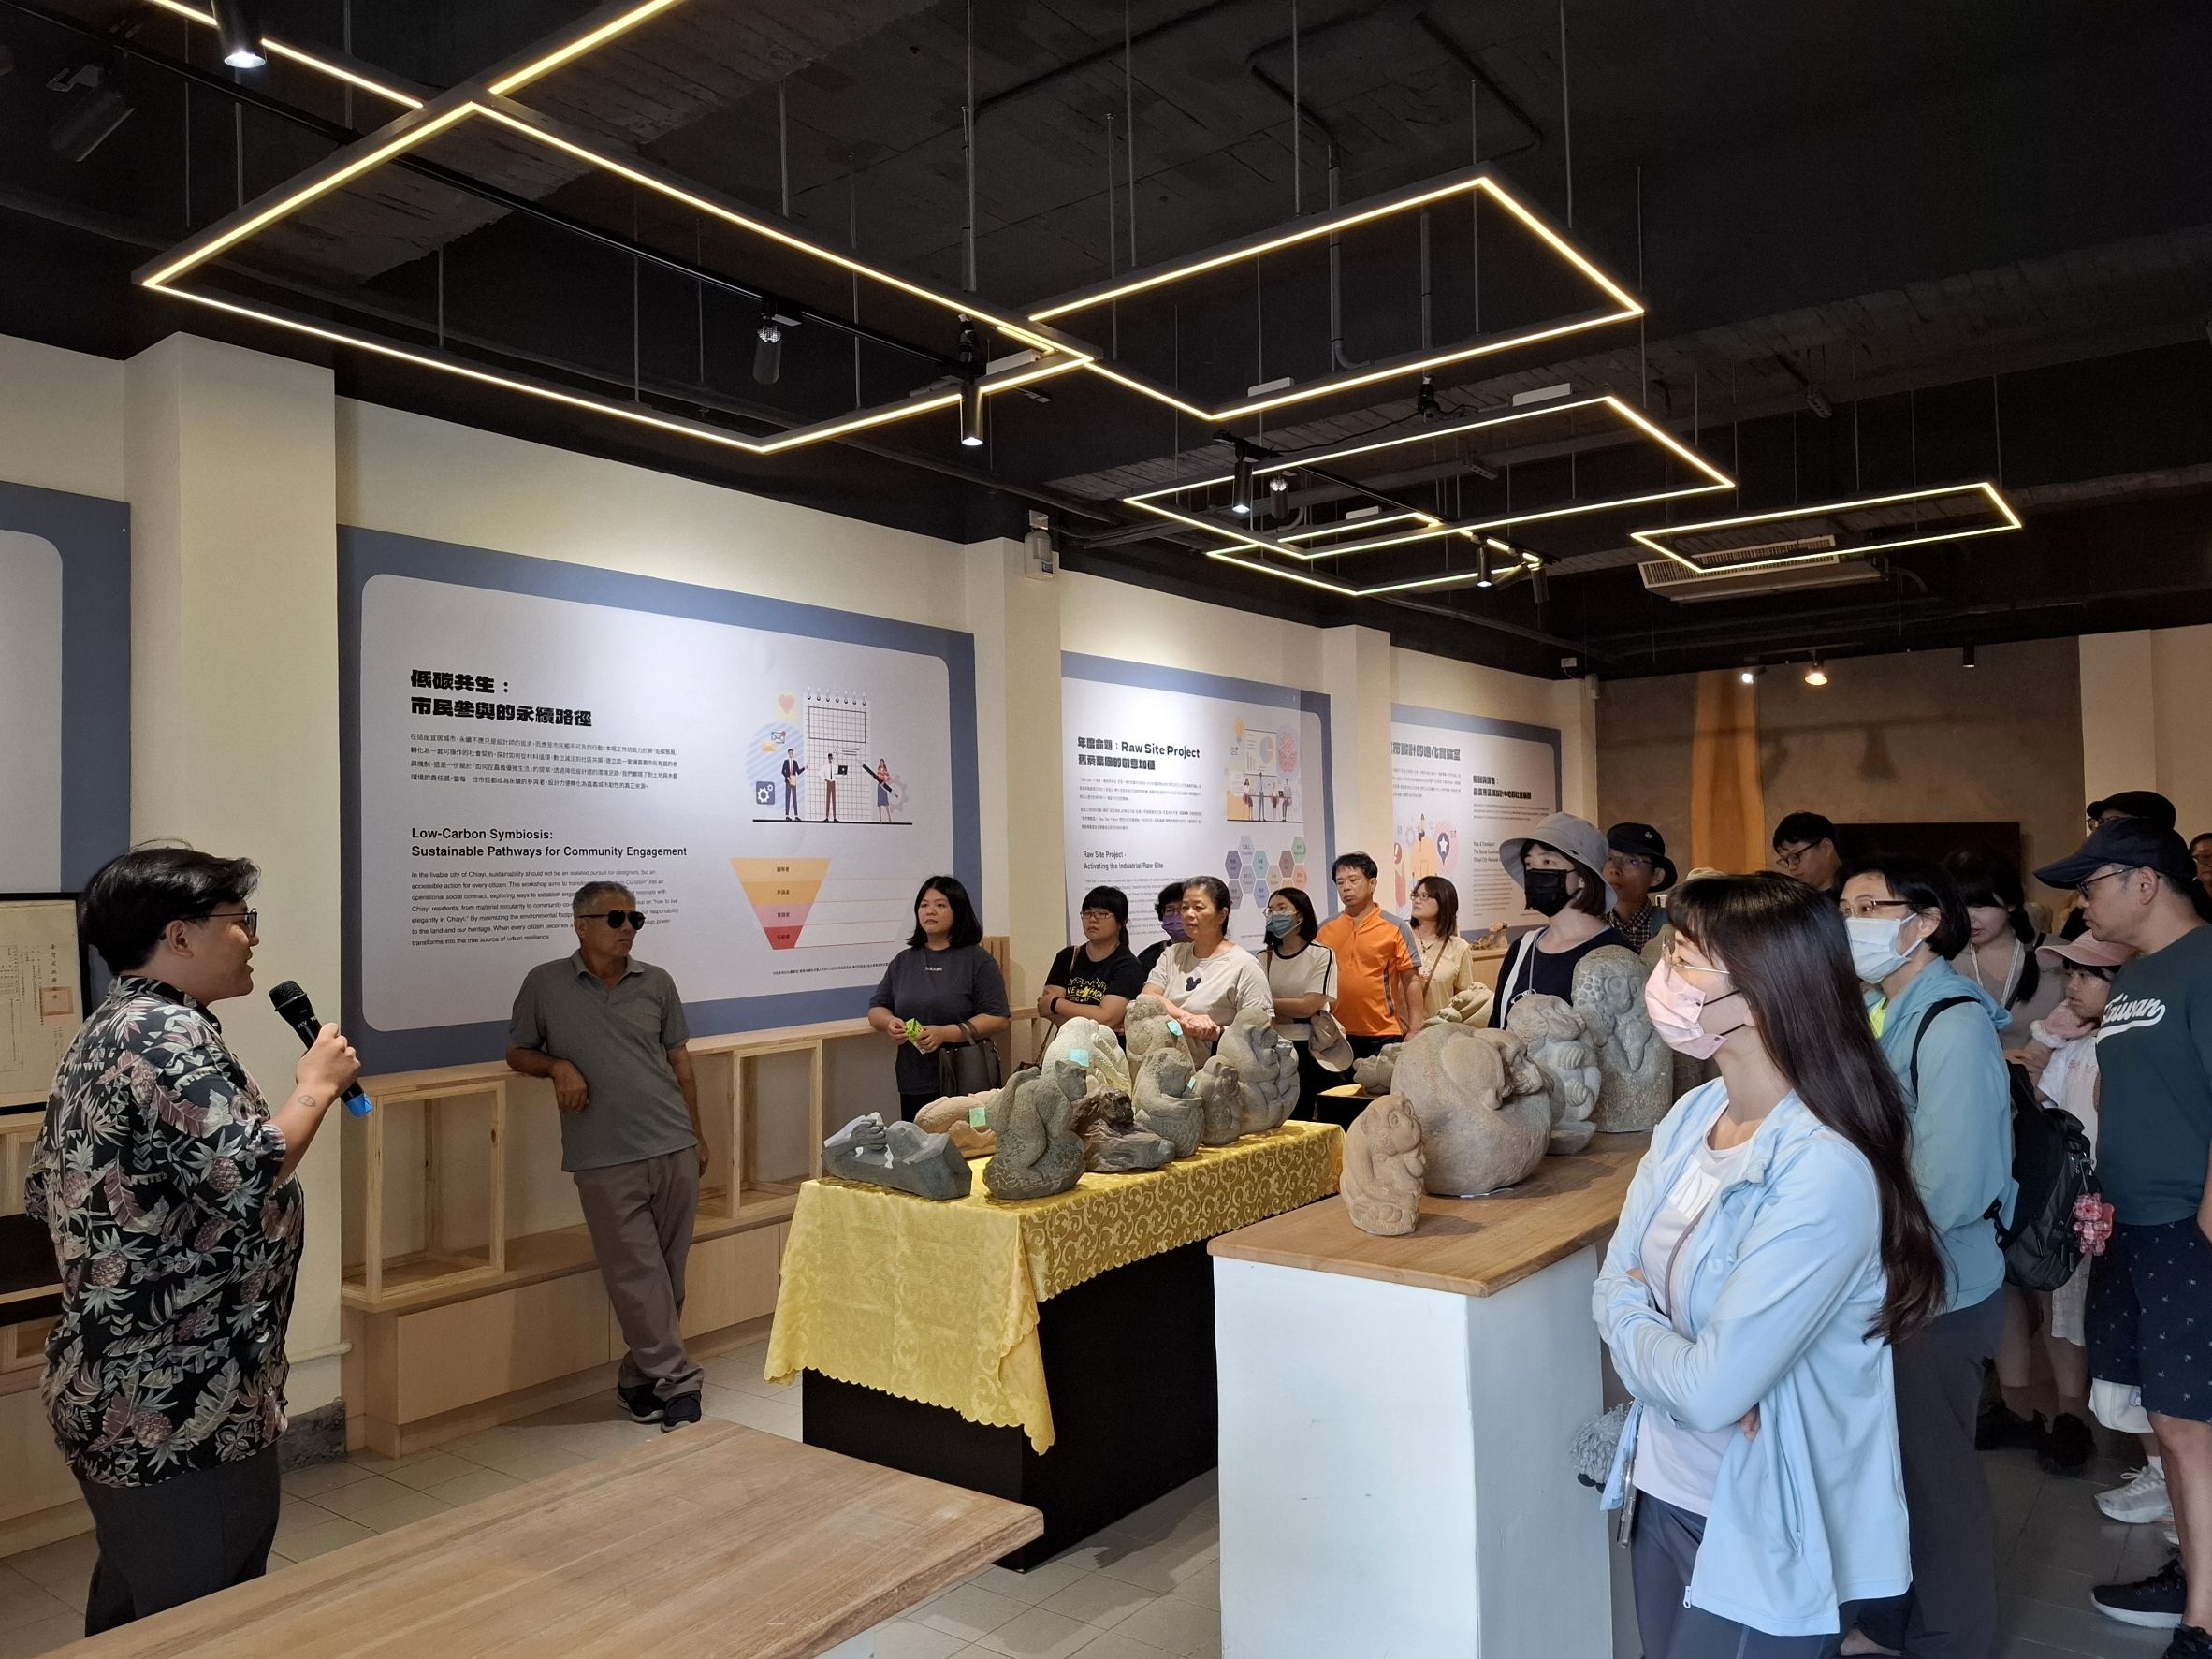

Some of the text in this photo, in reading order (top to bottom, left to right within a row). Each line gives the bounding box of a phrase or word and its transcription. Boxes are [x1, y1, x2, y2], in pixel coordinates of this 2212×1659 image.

[411, 670, 509, 693] 低碳共生：
[411, 696, 592, 727] 市民參與的永續路徑
[1121, 741, 1142, 754] Raw
[1144, 743, 1166, 755] Site
[1167, 745, 1201, 760] Project
[1391, 741, 1461, 761] 市設計的進化實驗室
[412, 827, 553, 842] Low-Carbon Symbiosis:
[412, 846, 687, 859] Sustainable Pathways for Community Engagement
[1106, 851, 1124, 859] Project
[450, 871, 460, 880] city
[488, 870, 524, 879] sustainability
[1084, 863, 1110, 871] Activating
[2101, 992, 2165, 1029] Taiwan
